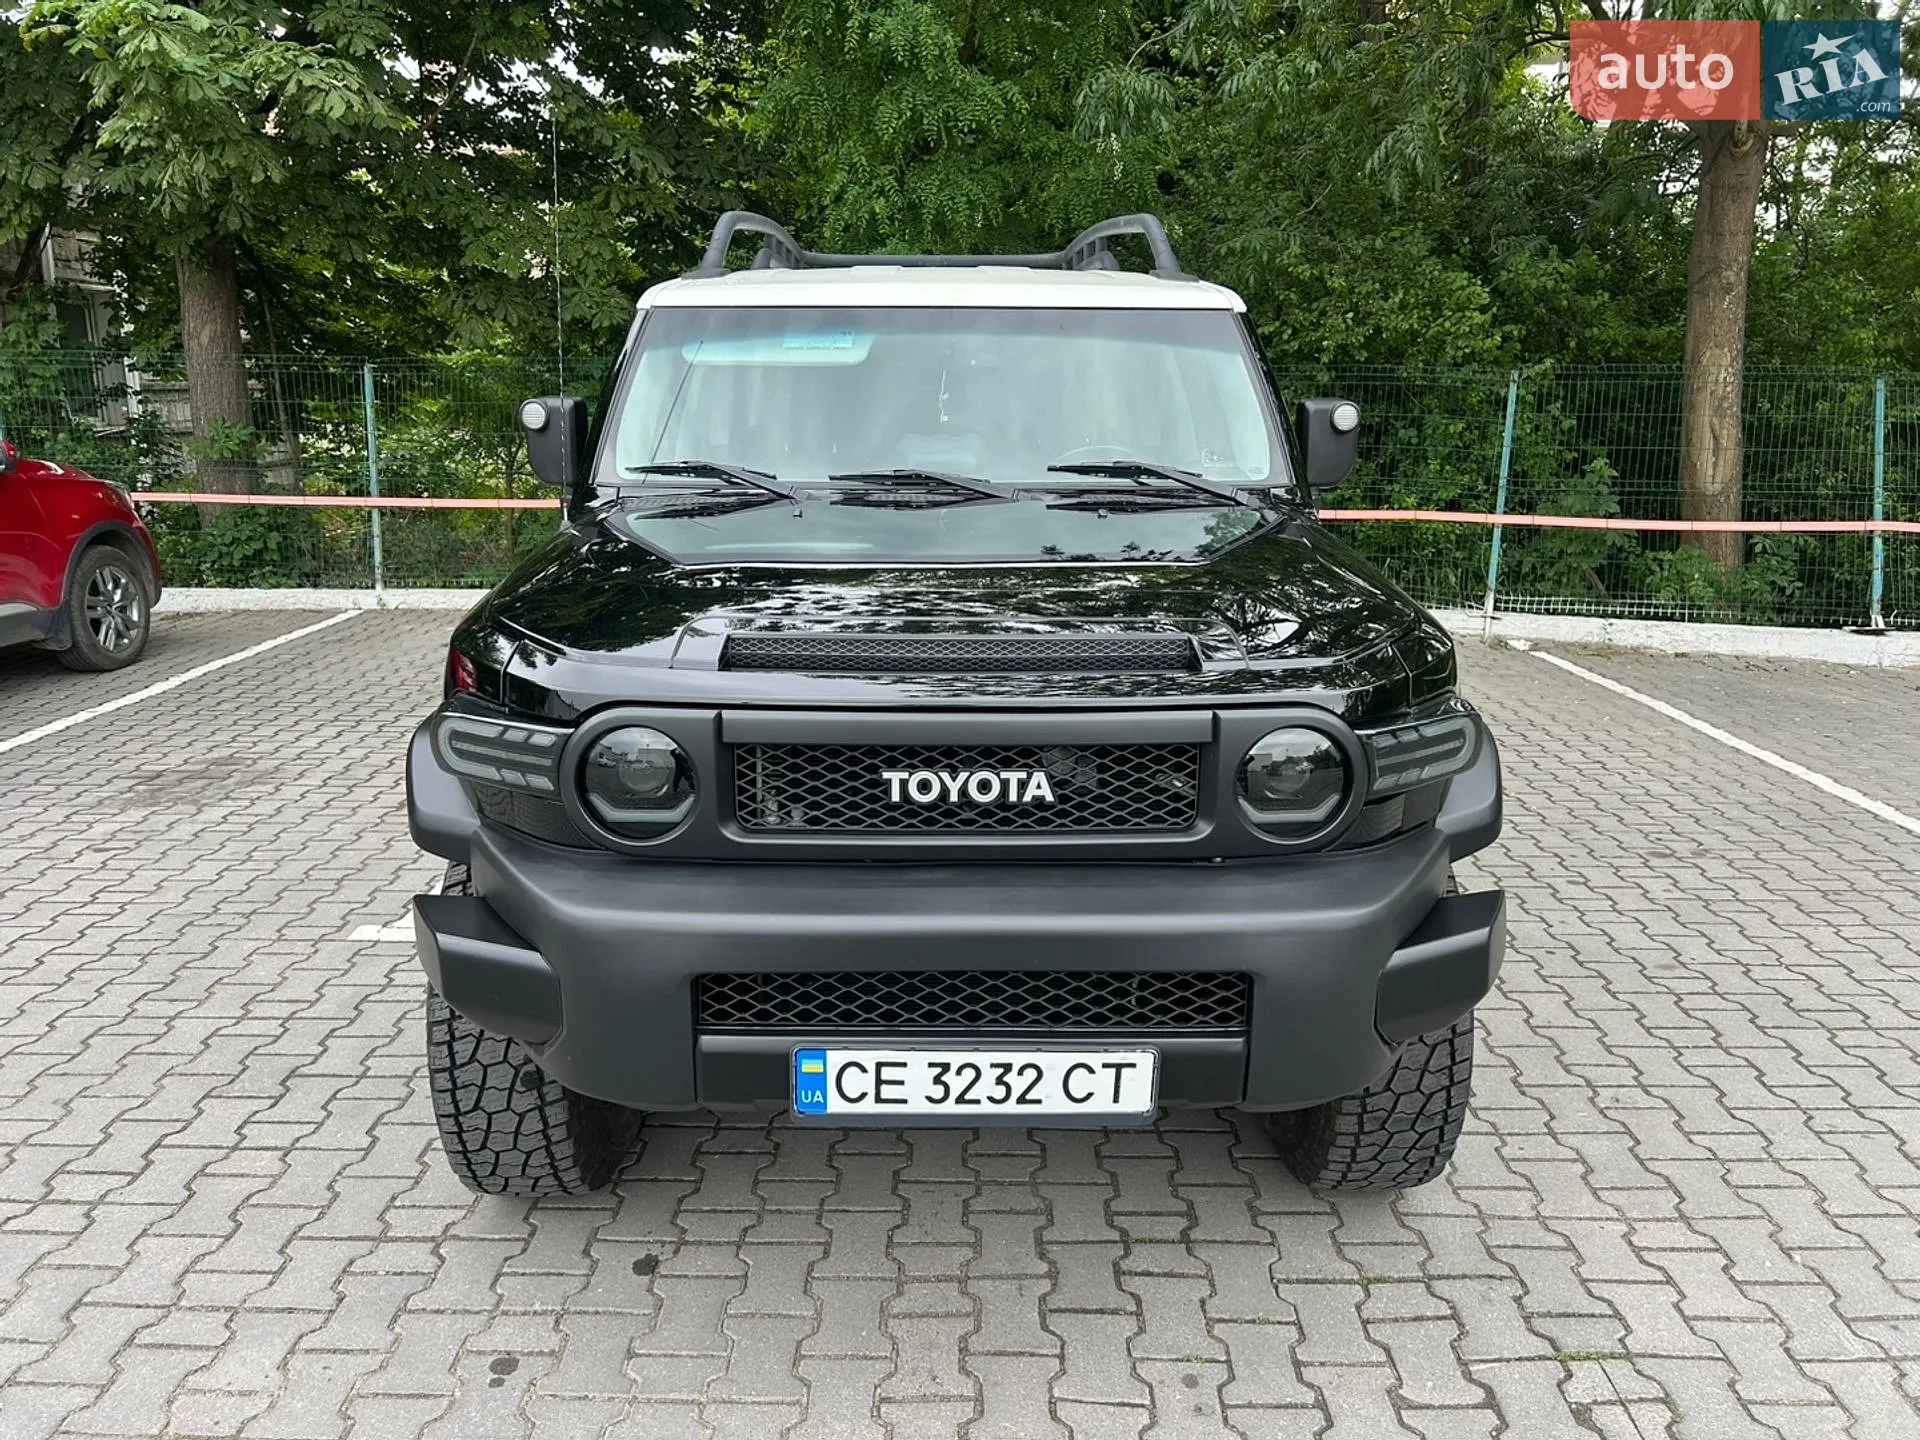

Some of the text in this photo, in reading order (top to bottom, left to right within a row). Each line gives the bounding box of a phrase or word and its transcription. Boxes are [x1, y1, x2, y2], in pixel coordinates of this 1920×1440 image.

[881, 770, 1055, 803] TOYOTA
[801, 1090, 824, 1104] UA
[835, 1061, 1137, 1105] CE 3232 CT
